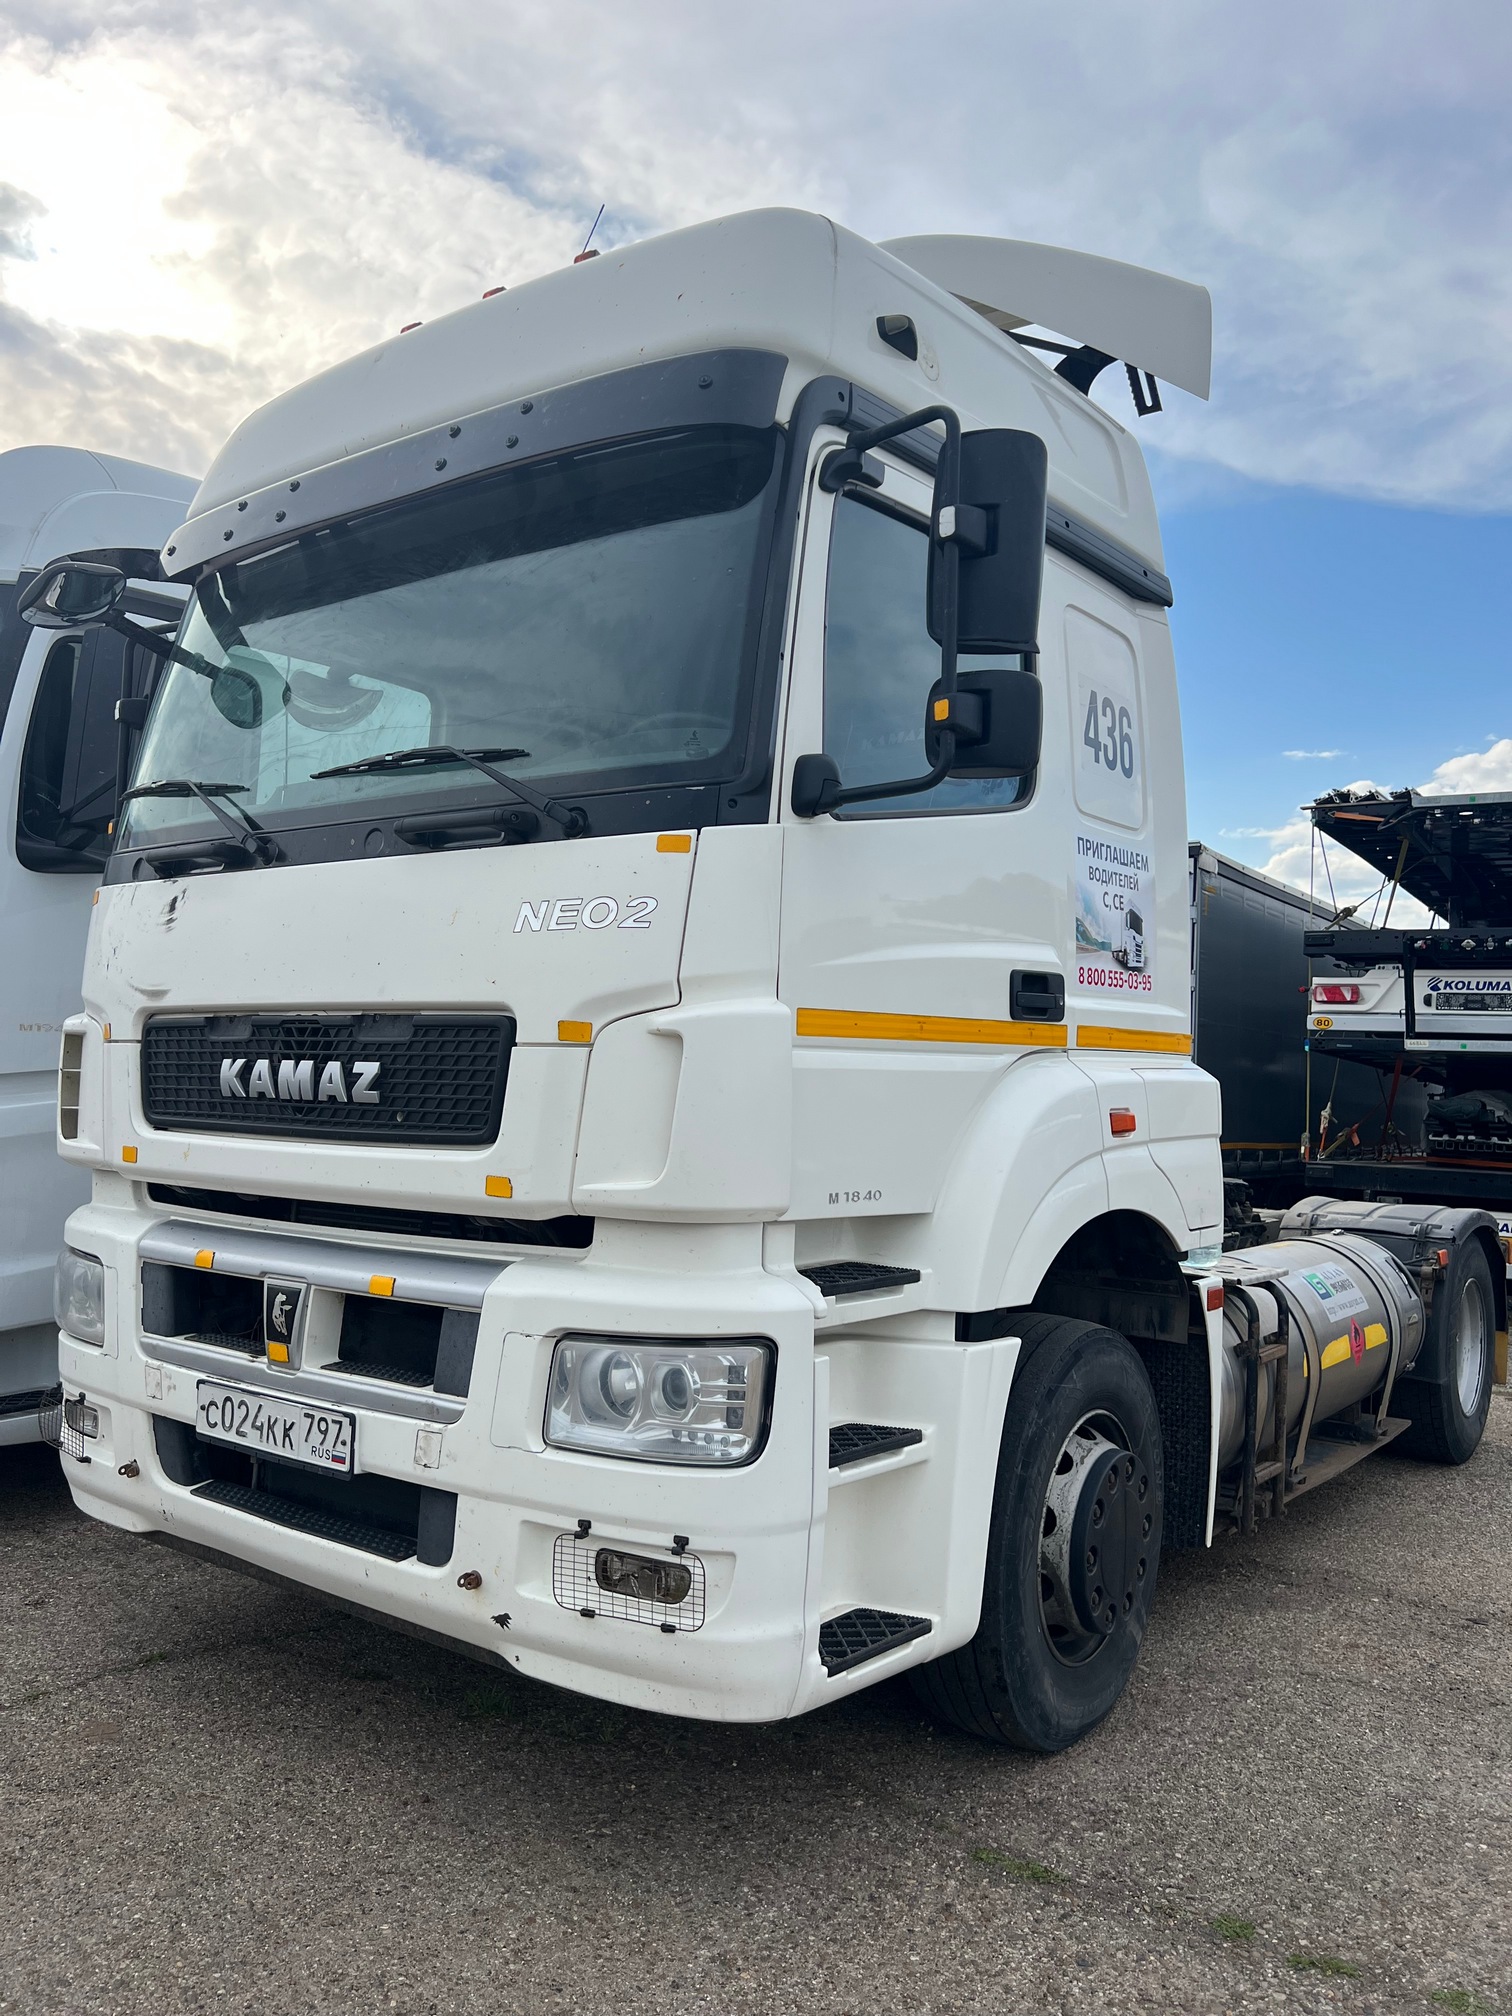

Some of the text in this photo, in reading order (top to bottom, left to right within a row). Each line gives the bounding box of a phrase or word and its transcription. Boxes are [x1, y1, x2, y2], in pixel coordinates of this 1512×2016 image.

[1084, 689, 1134, 779] 436
[1077, 836, 1150, 873] ПРИГЛАШАЕМ
[1088, 865, 1139, 892] ВОДИТЕЛЕЙ
[513, 895, 659, 933] NEO2
[1078, 966, 1152, 992] 8 800 555-03-95
[1316, 1019, 1330, 1027] 80
[219, 1058, 383, 1104] KAMAZ
[311, 1445, 331, 1460] RUS
